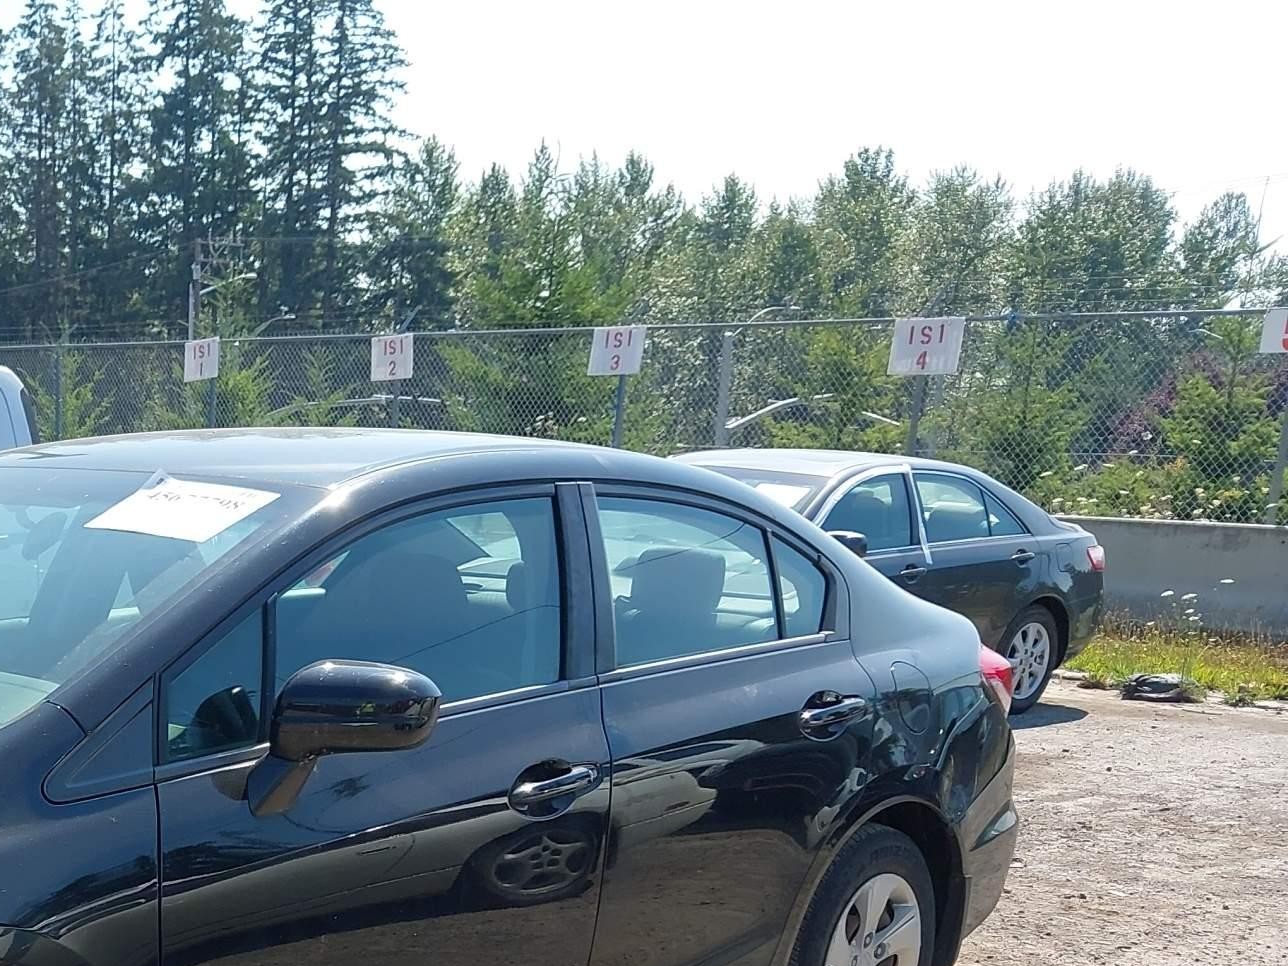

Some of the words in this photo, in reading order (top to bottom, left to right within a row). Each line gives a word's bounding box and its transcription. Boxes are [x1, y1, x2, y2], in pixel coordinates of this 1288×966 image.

[388, 360, 396, 376] 2
[610, 354, 620, 370] 3
[916, 351, 928, 370] 4
